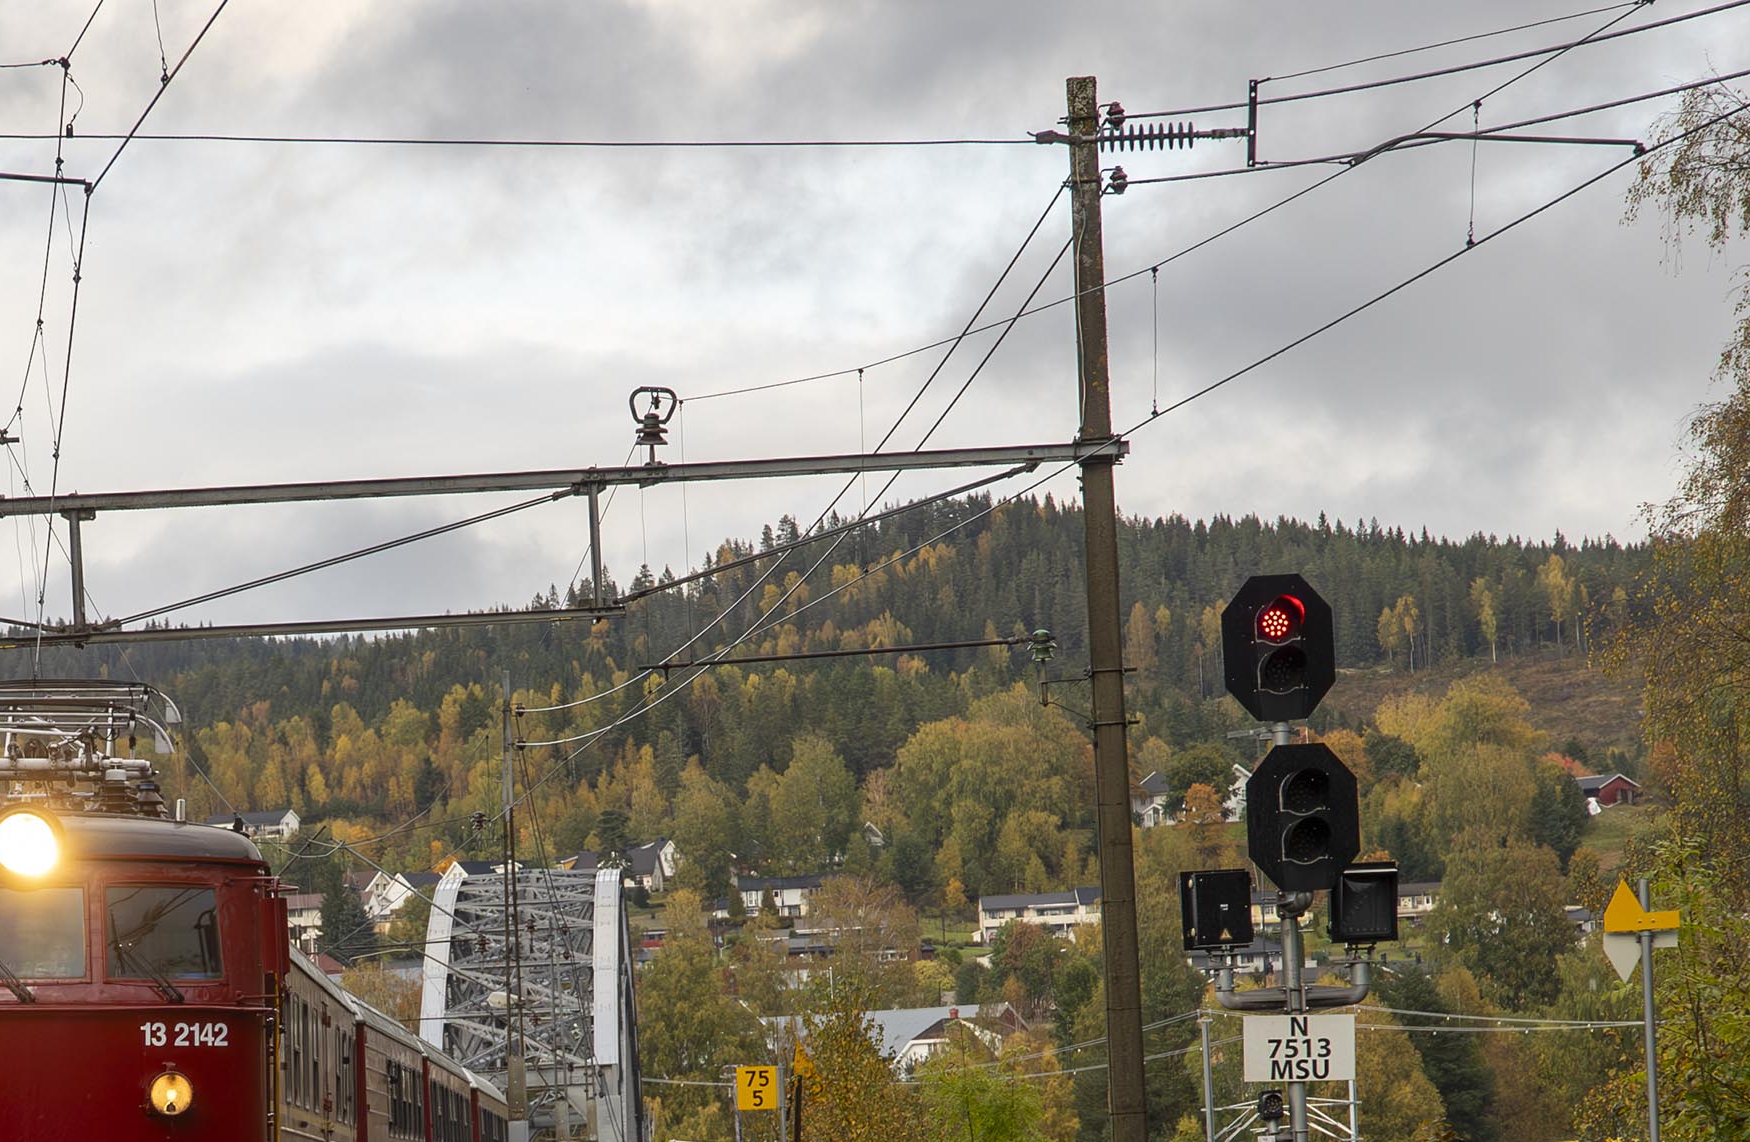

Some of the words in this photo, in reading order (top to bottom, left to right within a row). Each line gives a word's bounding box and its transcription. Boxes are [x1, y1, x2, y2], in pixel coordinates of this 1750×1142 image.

[140, 1022, 167, 1047] 13
[173, 1022, 228, 1047] 2142
[1290, 1016, 1308, 1037] N
[1267, 1038, 1332, 1059] 7513
[744, 1070, 770, 1088] 75
[1270, 1059, 1330, 1080] MSU
[752, 1089, 764, 1107] 5
